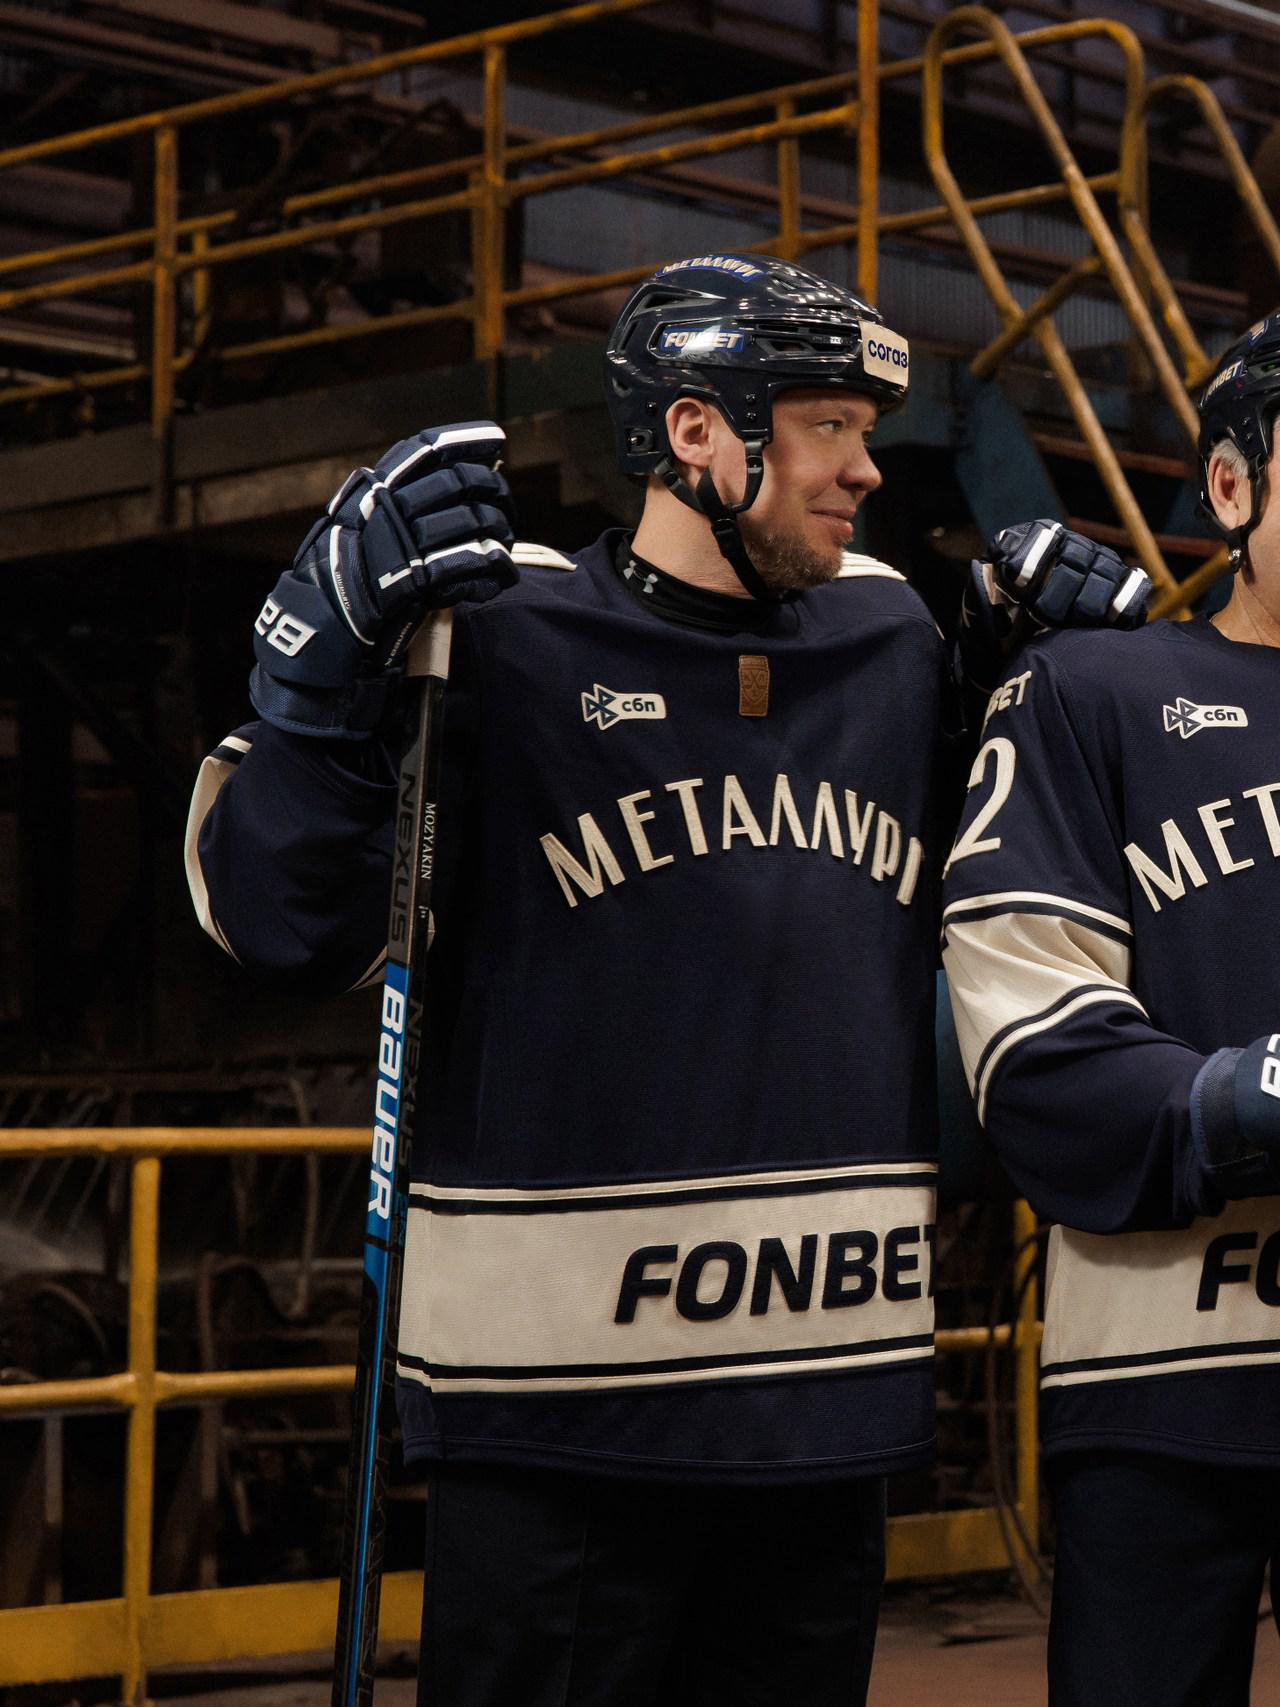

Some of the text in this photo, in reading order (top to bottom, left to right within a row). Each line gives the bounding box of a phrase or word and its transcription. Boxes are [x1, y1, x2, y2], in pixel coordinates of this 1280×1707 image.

[664, 332, 744, 349] FOET
[868, 338, 908, 369] согаз
[621, 697, 656, 713] сбп
[982, 670, 1032, 726] BET
[1203, 708, 1239, 722] сбп
[420, 802, 437, 880] MOZYAKIN
[391, 772, 416, 944] NEXUS
